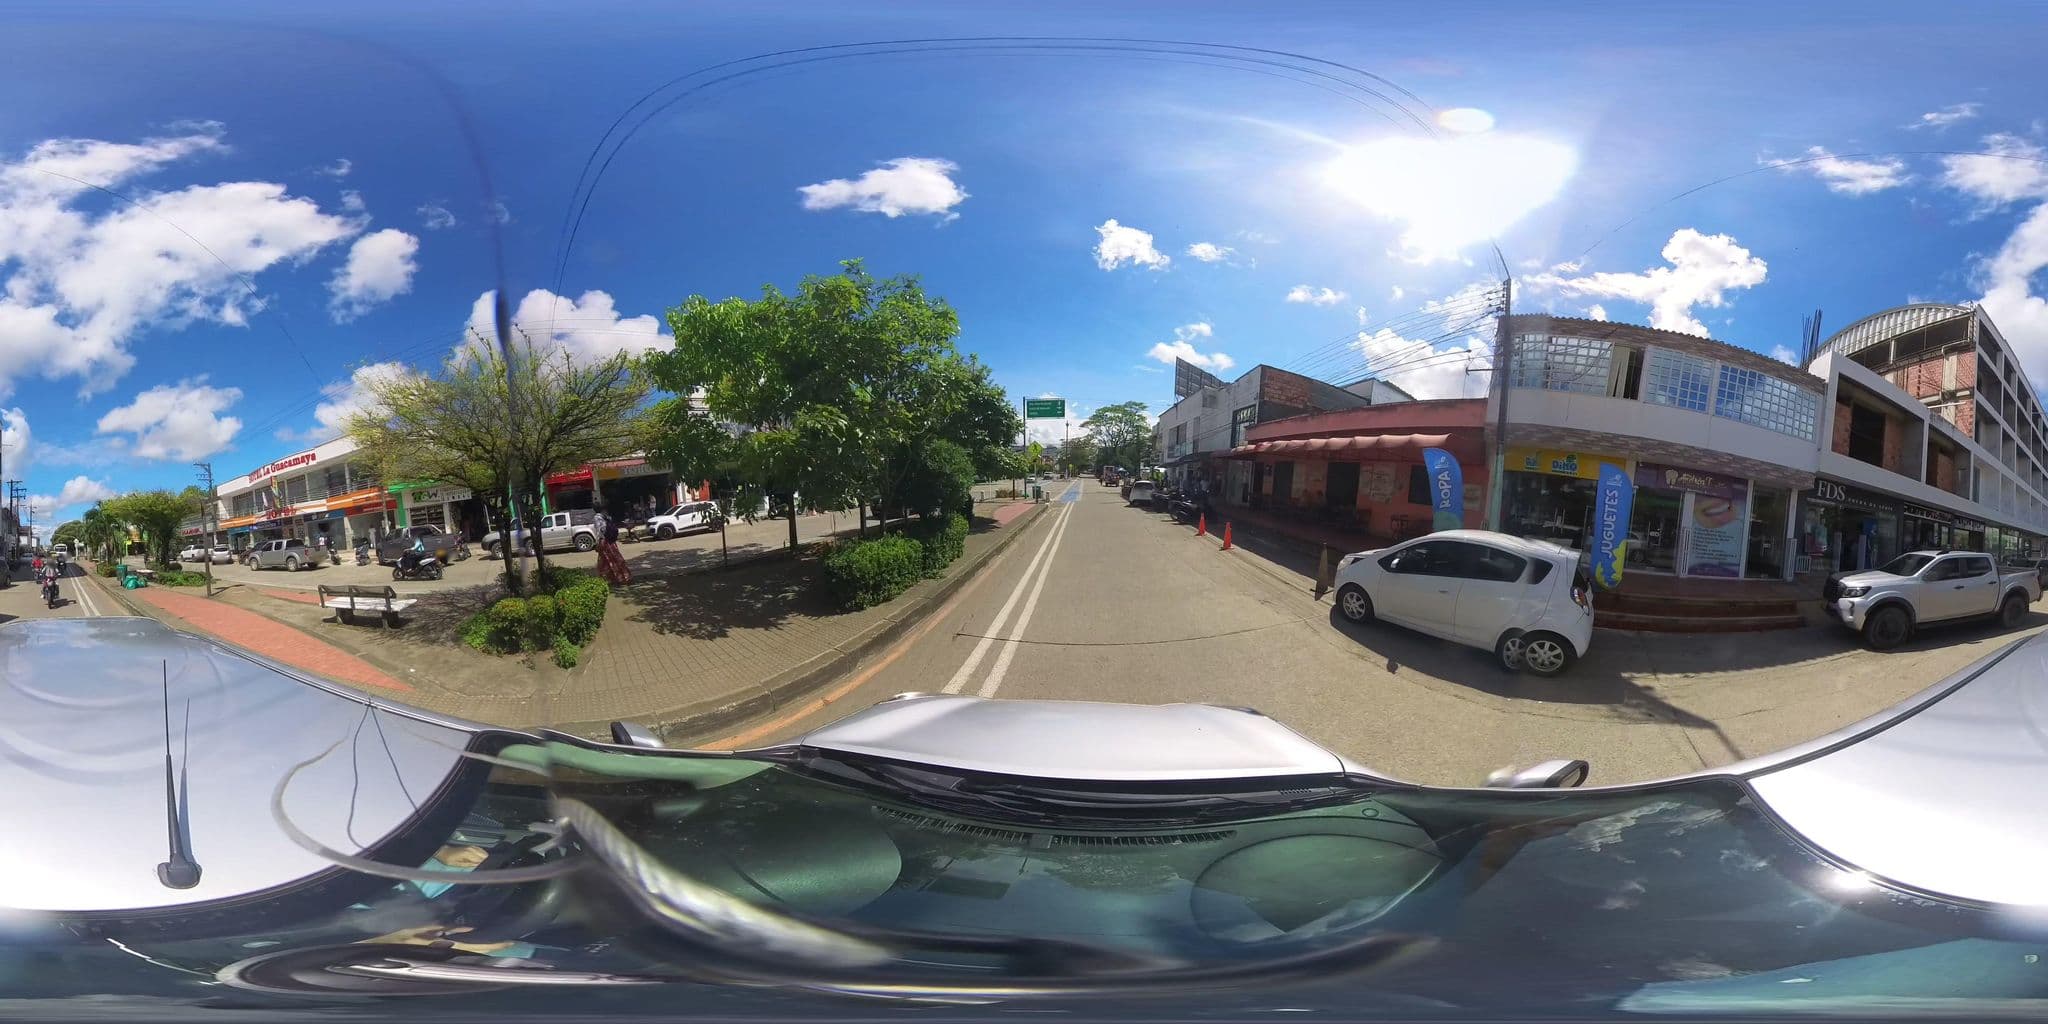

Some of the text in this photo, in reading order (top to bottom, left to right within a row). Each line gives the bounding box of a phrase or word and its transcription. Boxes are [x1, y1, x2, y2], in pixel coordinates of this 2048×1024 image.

[271, 452, 316, 472] Guacamaya
[1438, 470, 1452, 509] ROPA
[1817, 479, 1846, 501] FDS
[1601, 489, 1619, 558] JUGUETES
